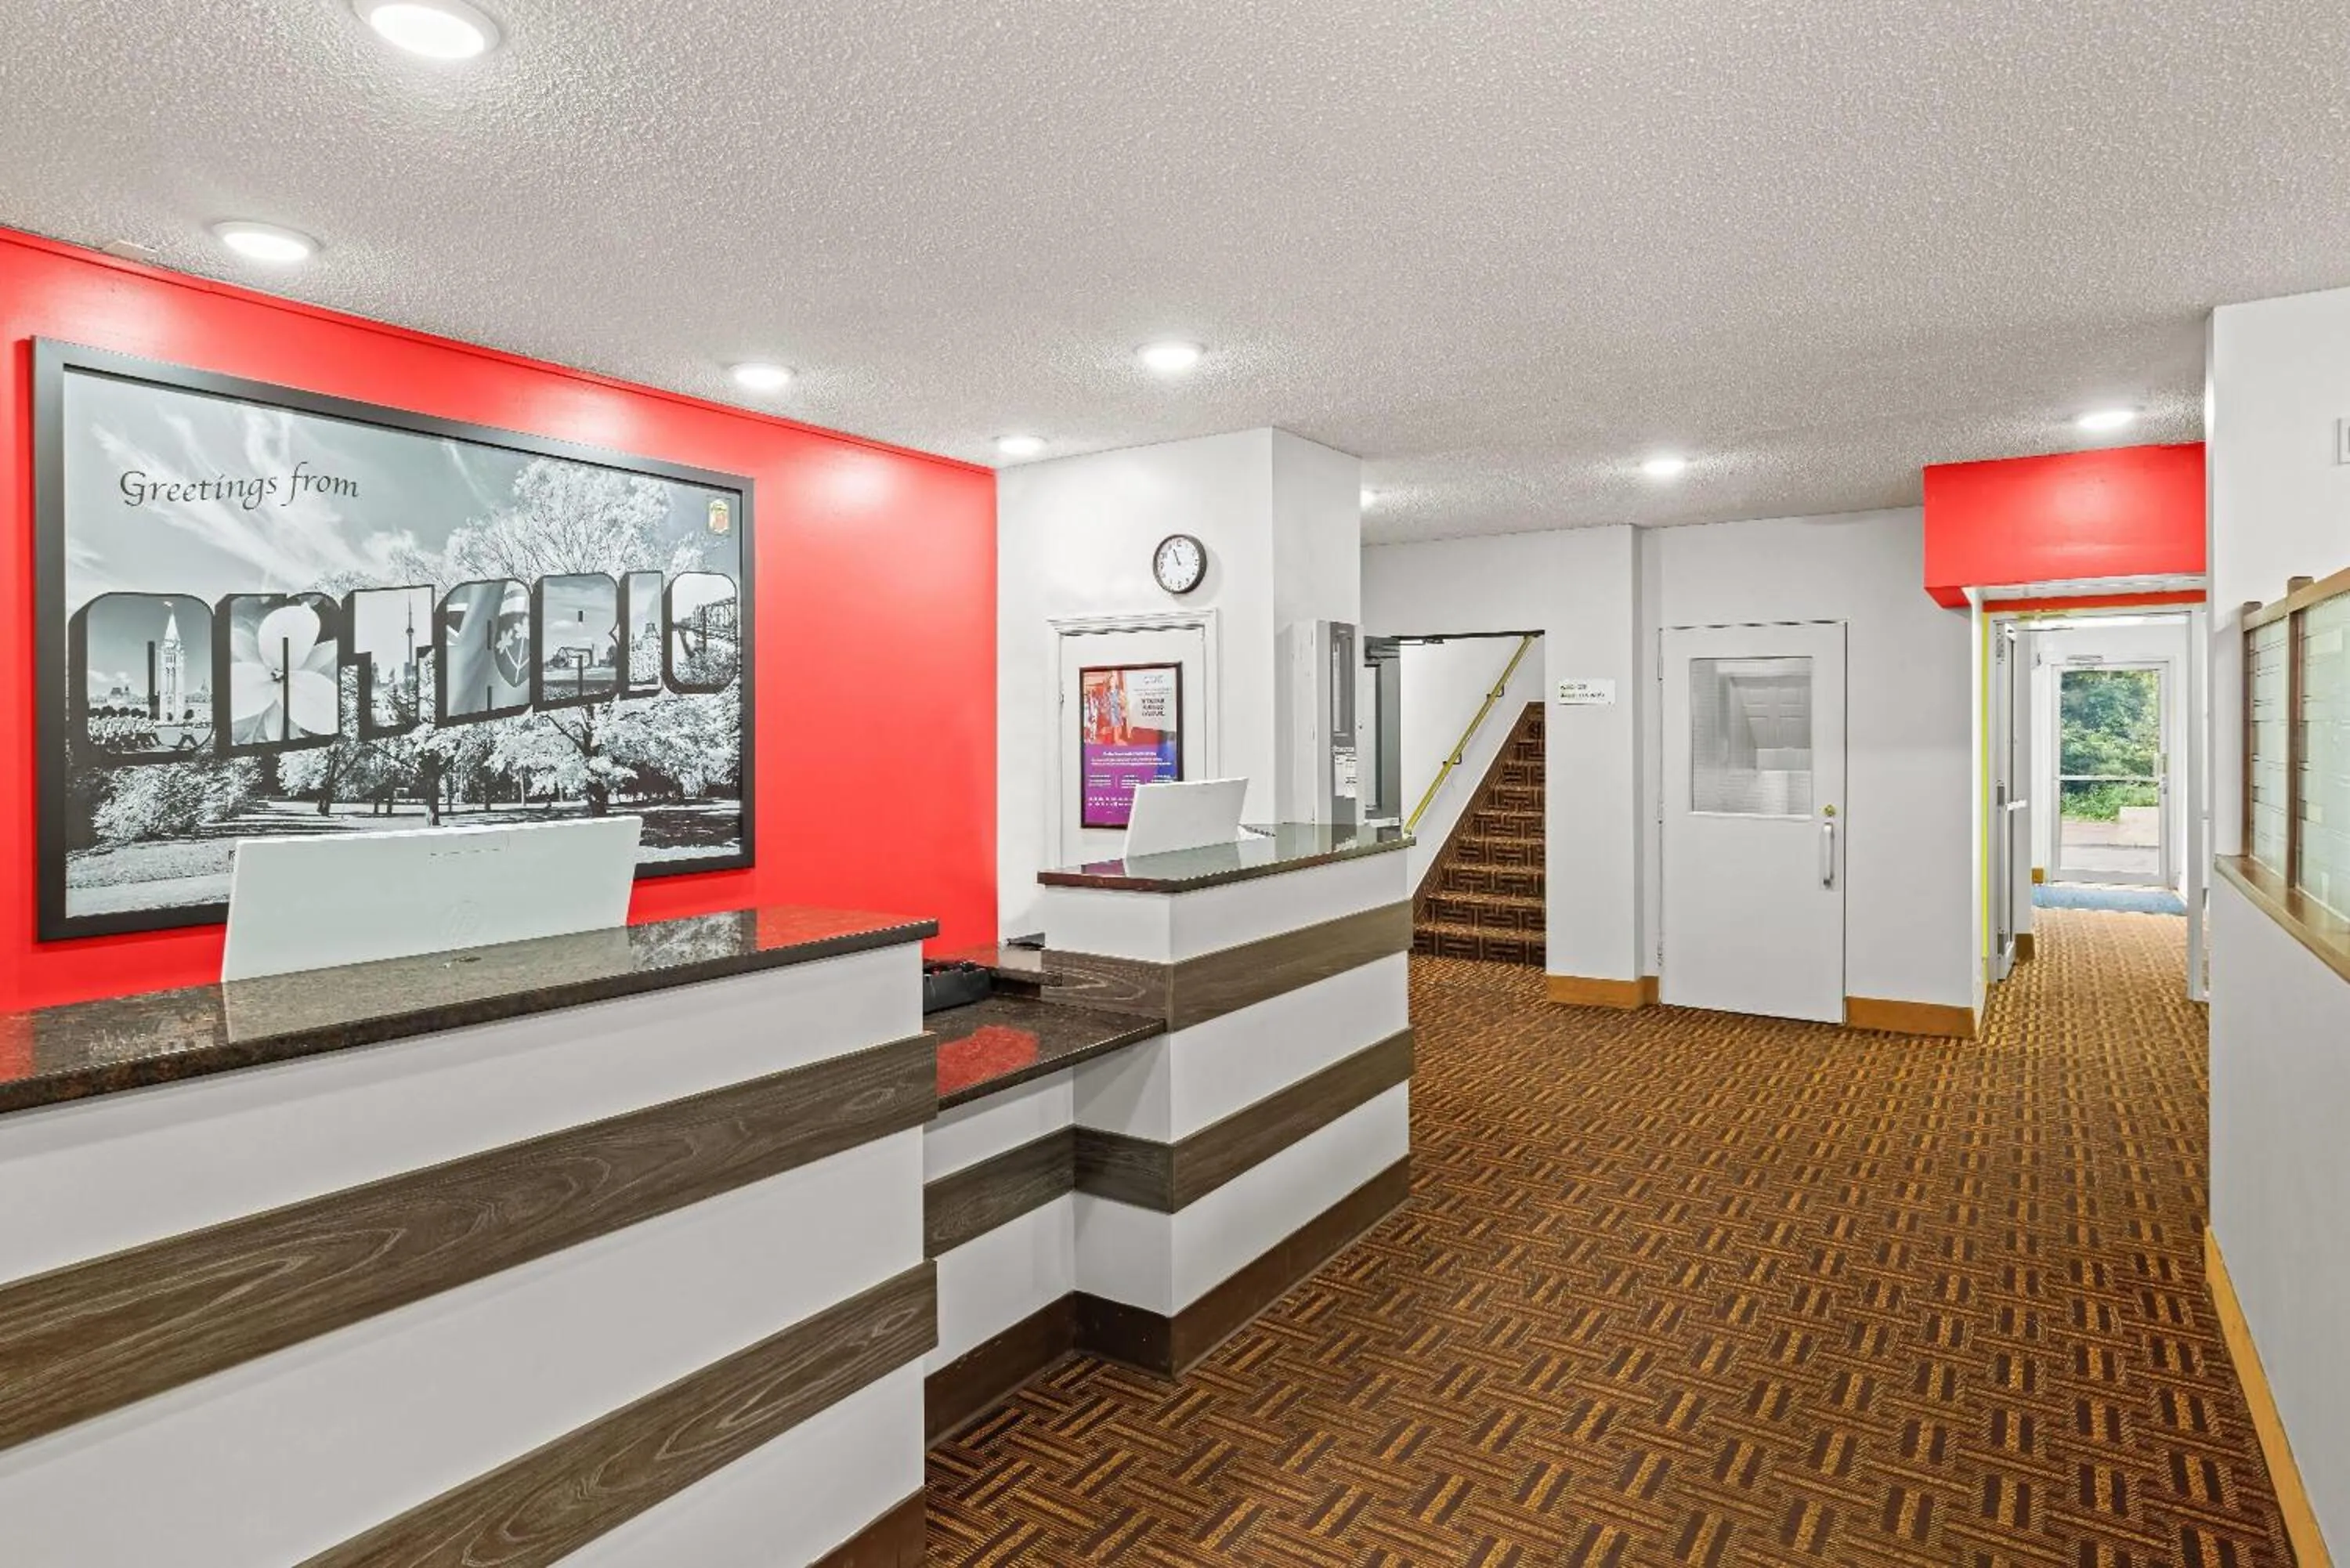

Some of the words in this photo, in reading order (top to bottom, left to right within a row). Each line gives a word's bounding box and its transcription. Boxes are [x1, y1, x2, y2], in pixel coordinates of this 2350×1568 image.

[119, 470, 278, 510] Greetings
[280, 461, 360, 507] from
[67, 570, 739, 764] ONTARIO
